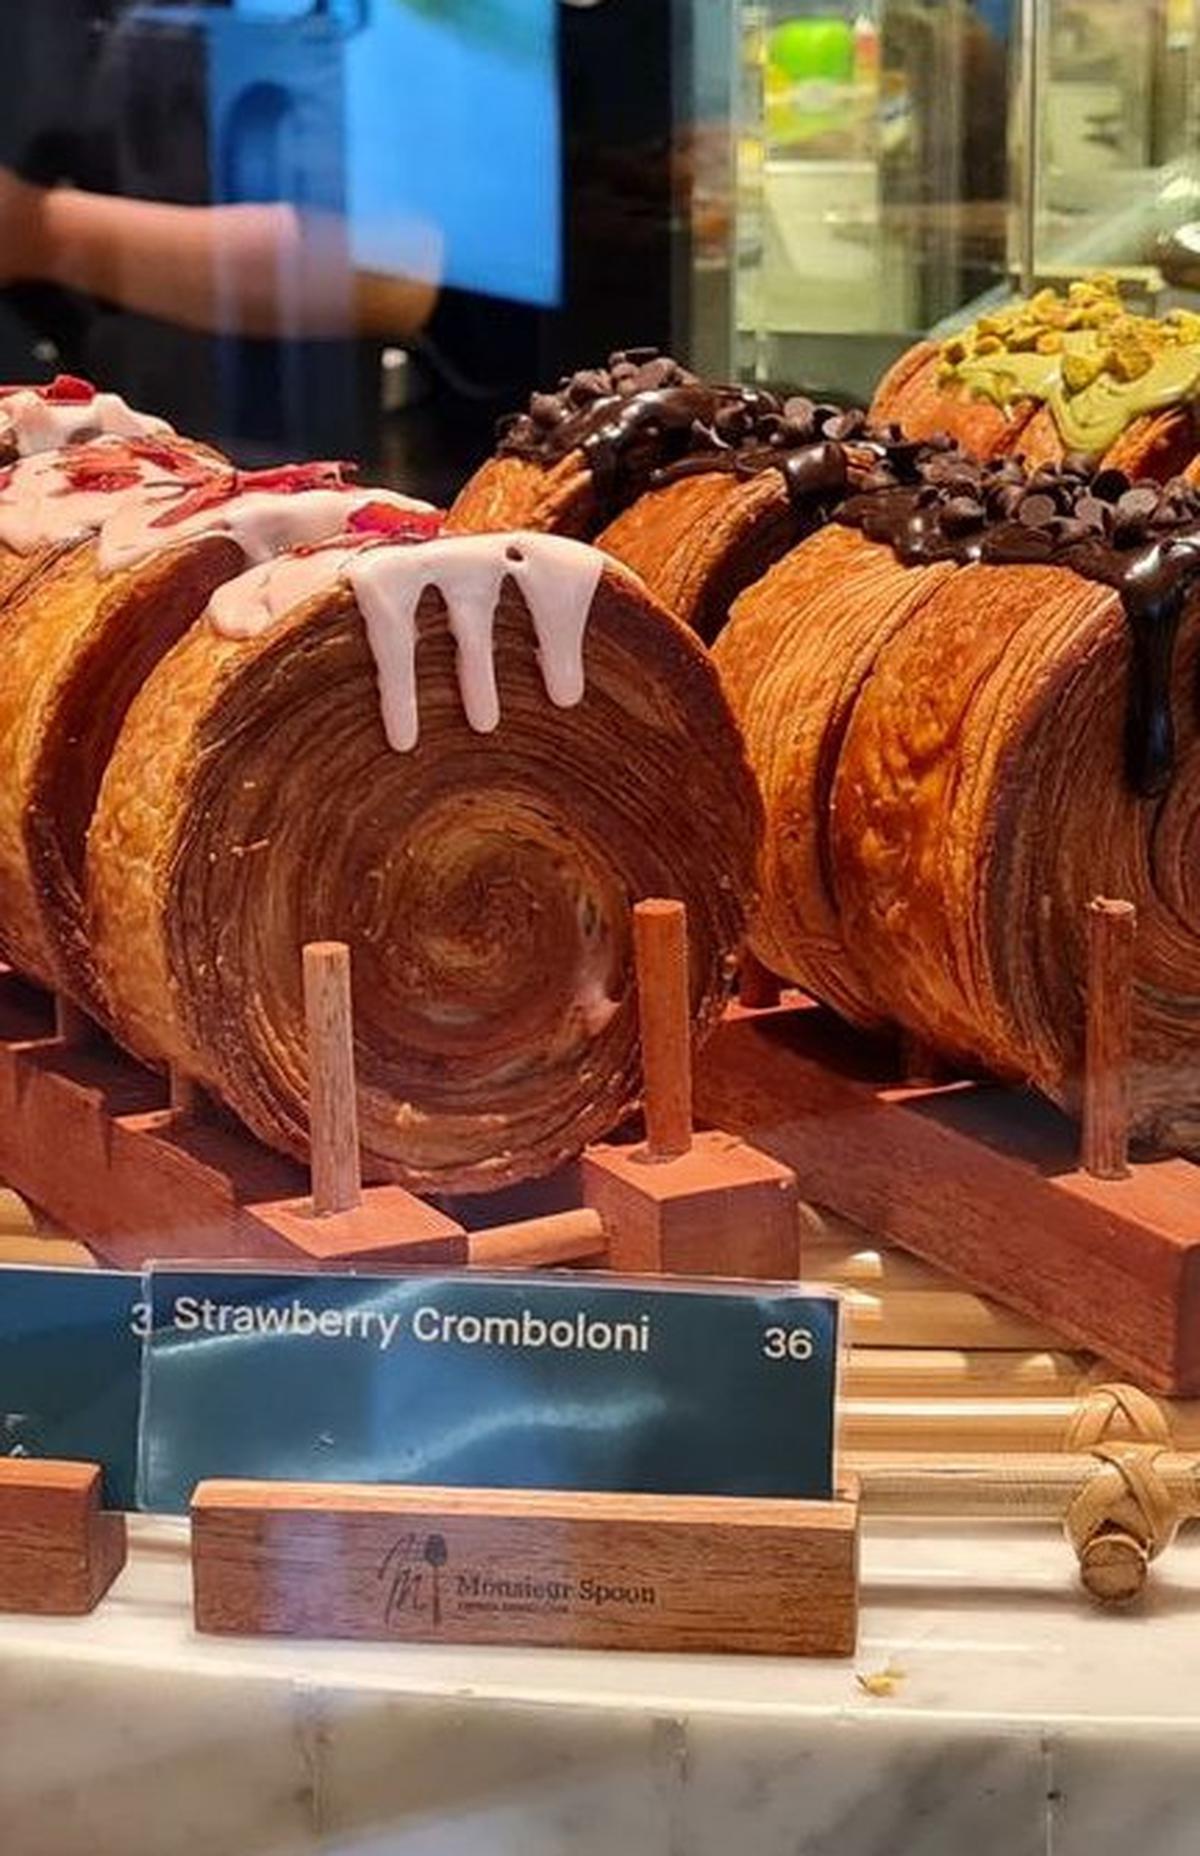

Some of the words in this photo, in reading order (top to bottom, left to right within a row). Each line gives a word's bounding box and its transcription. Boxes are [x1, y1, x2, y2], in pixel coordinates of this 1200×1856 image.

[174, 1296, 400, 1350] Strawberry
[412, 1306, 650, 1351] Cromboloni
[764, 1327, 813, 1360] 36
[456, 1574, 571, 1602] Monsieur
[578, 1577, 656, 1606] Spoon
